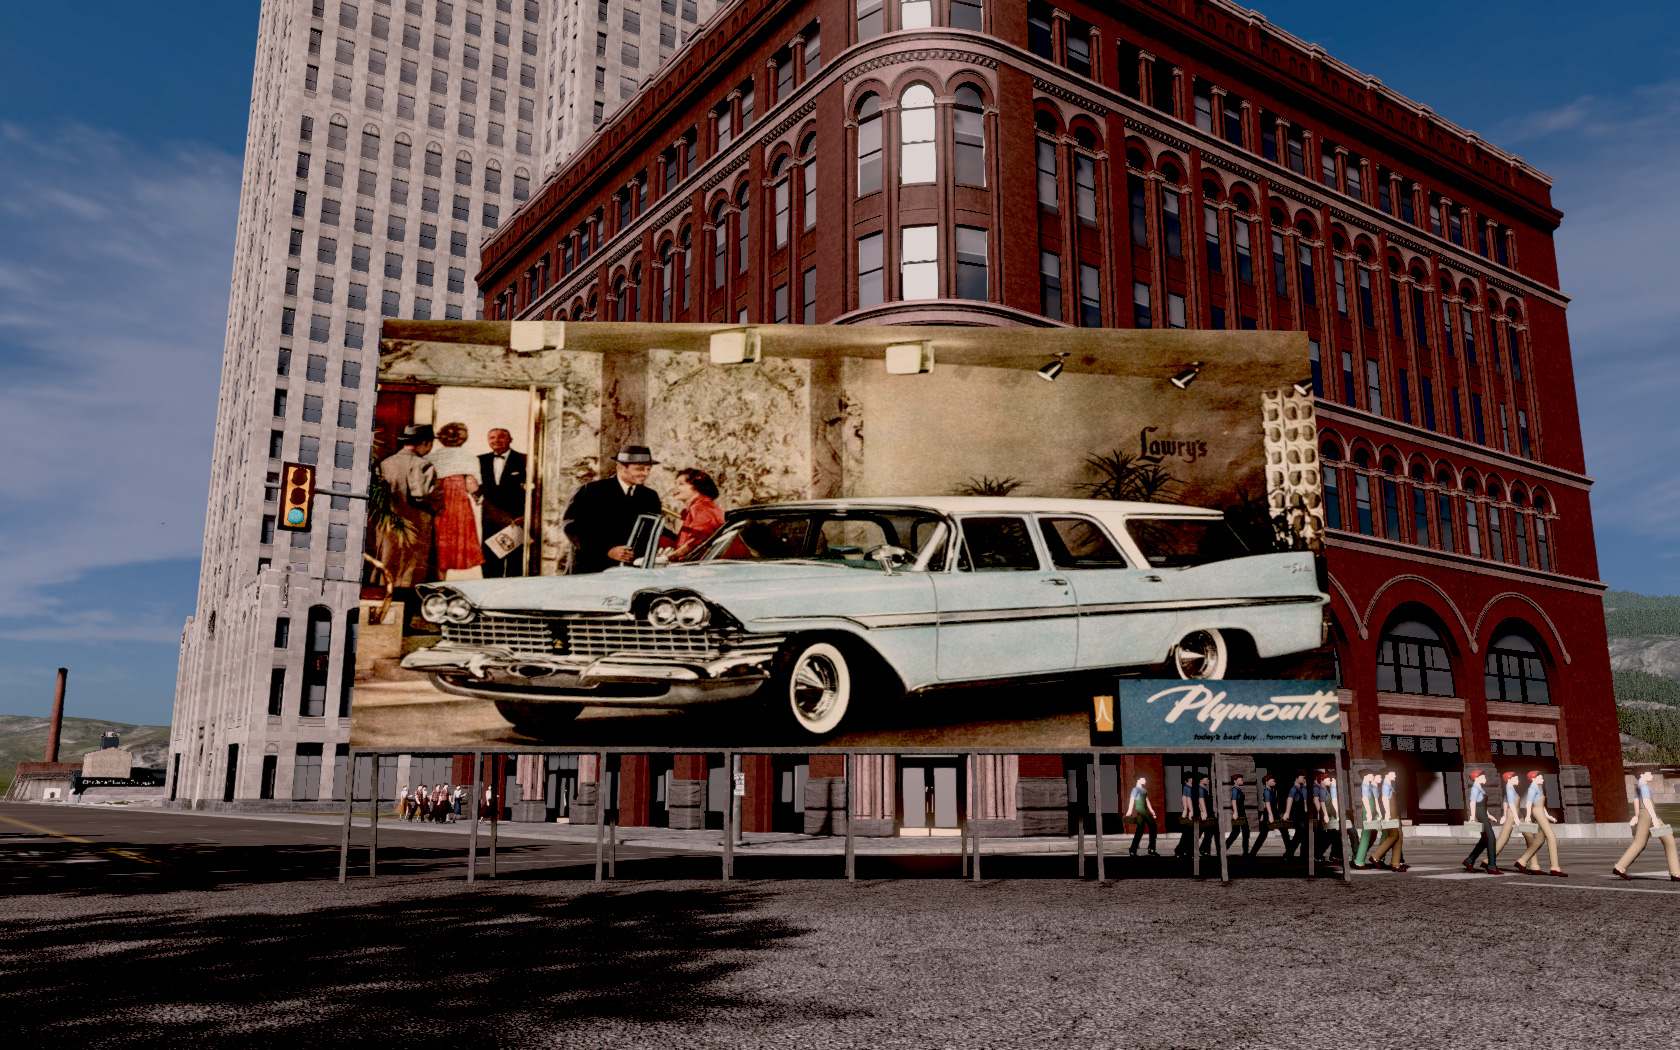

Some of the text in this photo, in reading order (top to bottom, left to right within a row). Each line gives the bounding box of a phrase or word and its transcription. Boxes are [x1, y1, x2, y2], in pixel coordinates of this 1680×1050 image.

[1137, 426, 1208, 464] Lawry's
[1146, 684, 1339, 732] Plymouth
[1193, 732, 1220, 743] today's
[1223, 732, 1242, 741] best
[1310, 733, 1328, 741] best
